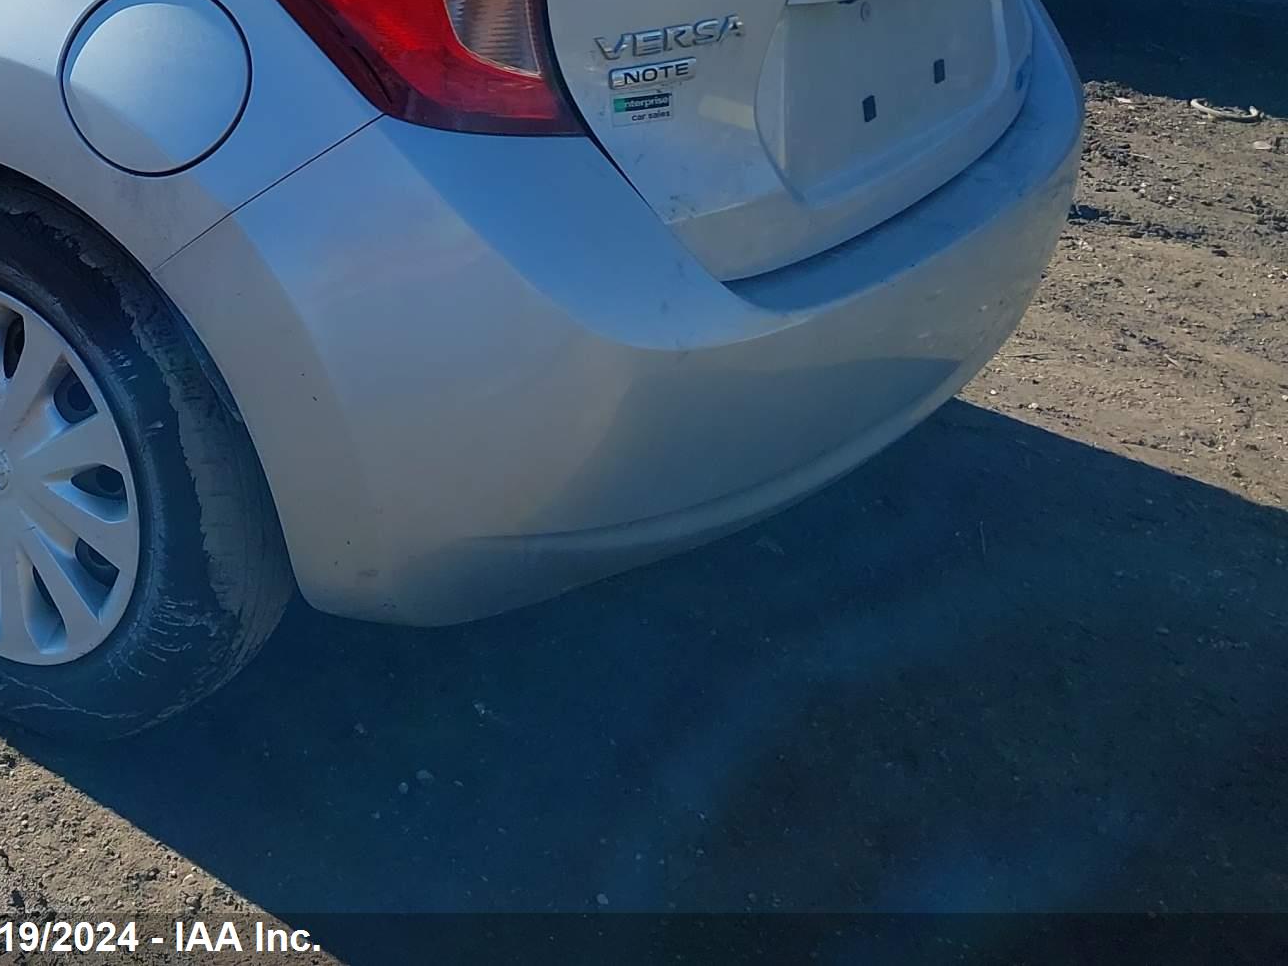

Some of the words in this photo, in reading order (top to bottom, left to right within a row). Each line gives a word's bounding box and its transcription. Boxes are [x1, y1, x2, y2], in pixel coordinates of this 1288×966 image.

[595, 14, 744, 60] VERSA
[623, 63, 689, 85] NOTE
[615, 94, 669, 111] nterprise
[631, 113, 646, 121] car
[647, 110, 670, 120] sales
